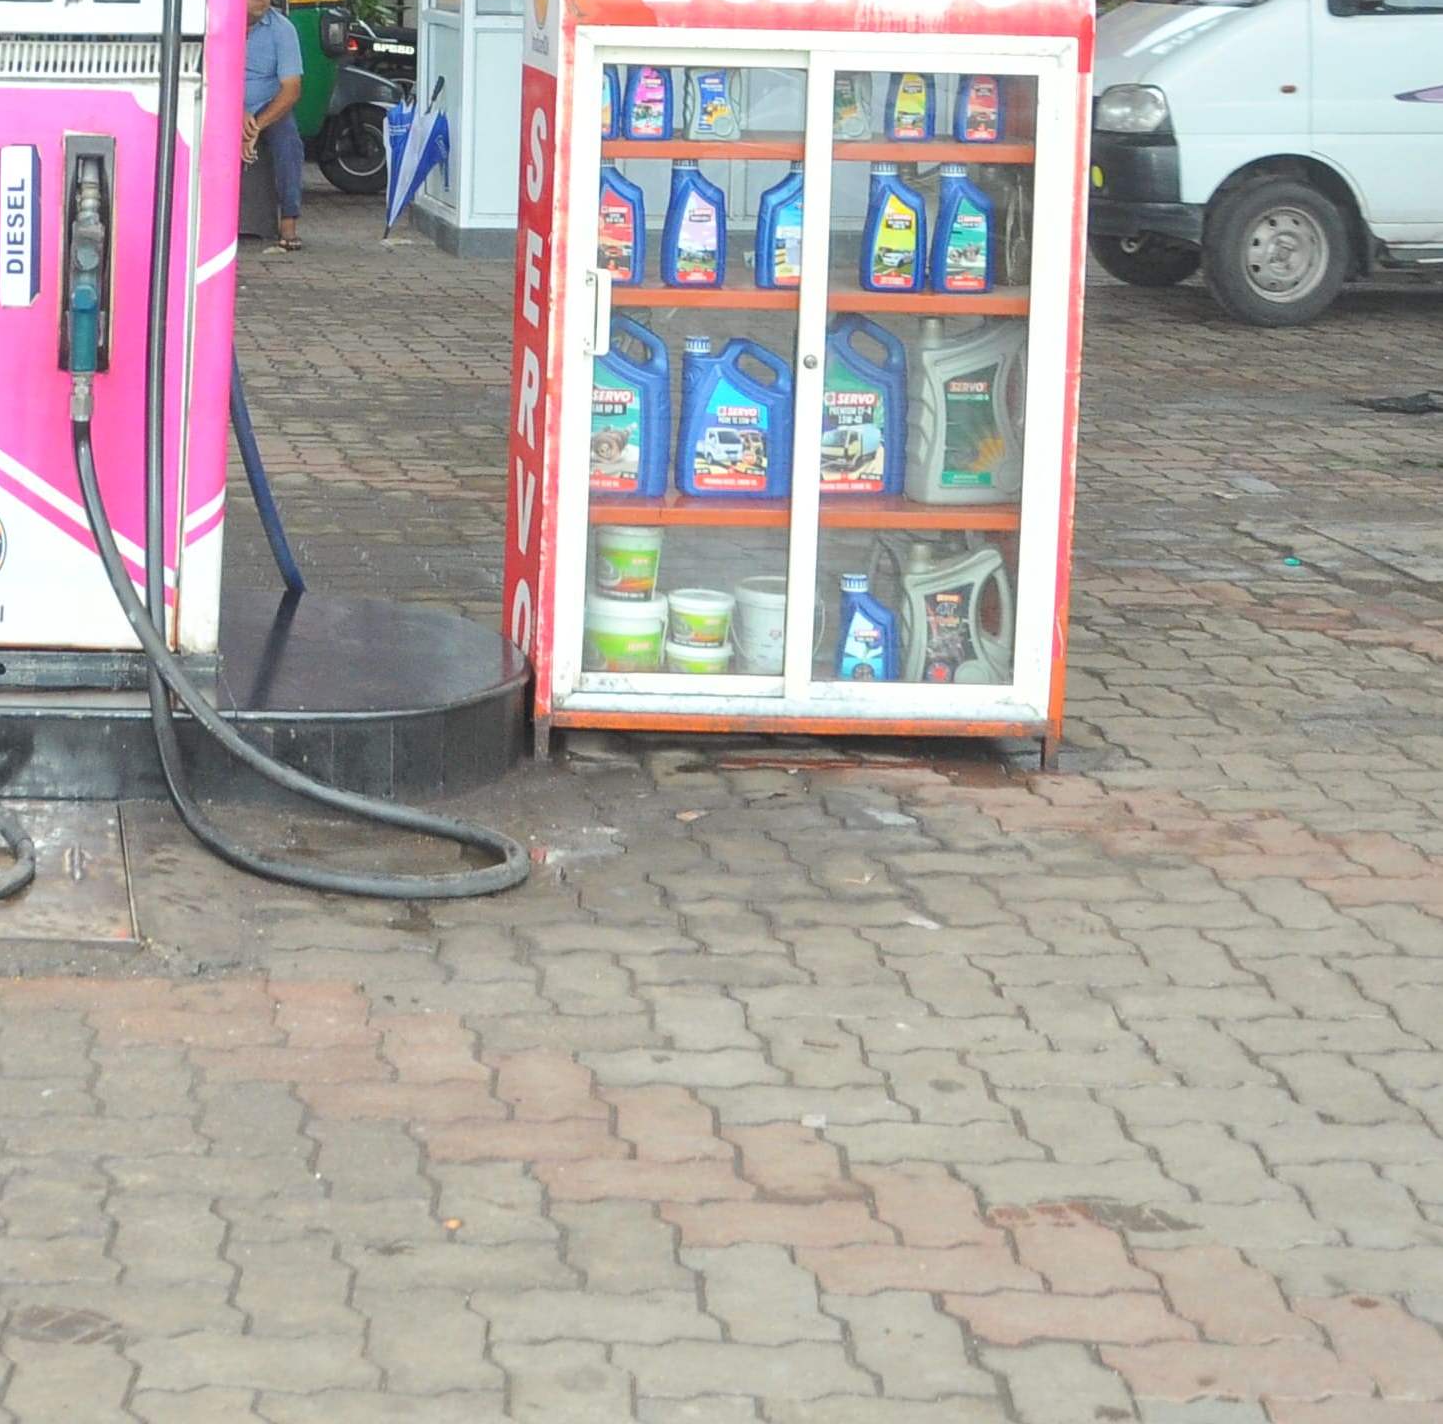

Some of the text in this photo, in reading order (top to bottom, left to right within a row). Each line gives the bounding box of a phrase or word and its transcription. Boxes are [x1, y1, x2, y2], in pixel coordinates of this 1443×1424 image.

[7, 178, 25, 275] DIESEL
[950, 381, 986, 393] SERVO
[836, 393, 876, 405] SERVO
[726, 407, 758, 417] SERVO
